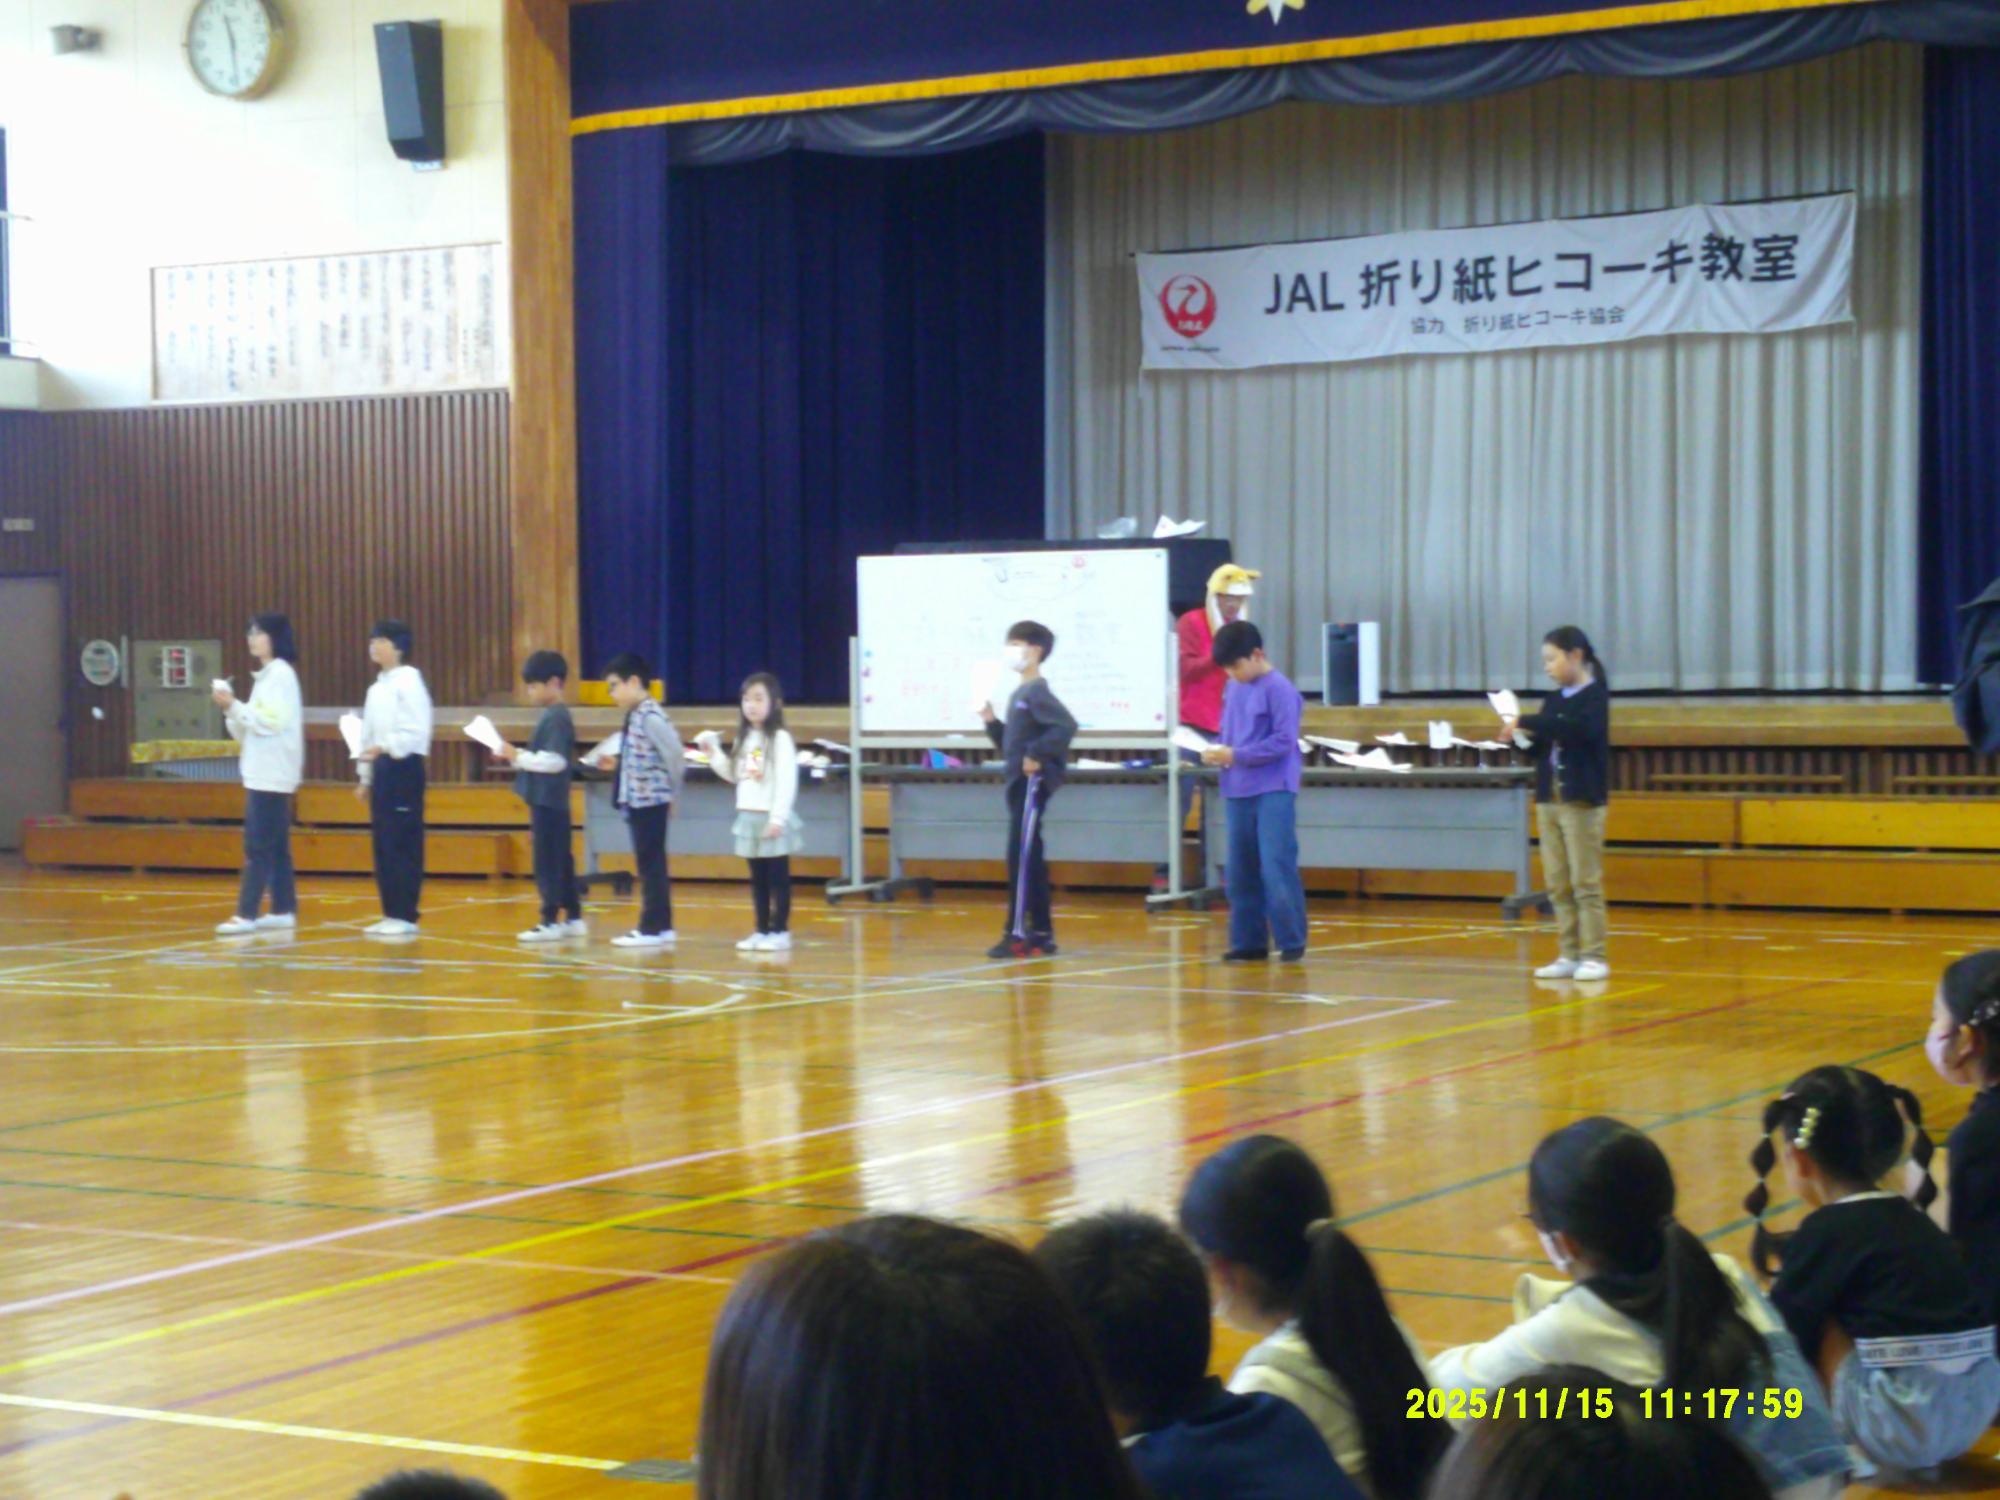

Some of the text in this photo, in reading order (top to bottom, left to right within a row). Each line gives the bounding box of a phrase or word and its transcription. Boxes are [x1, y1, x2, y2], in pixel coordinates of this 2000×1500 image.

[1264, 234, 1799, 315] JAL 折り紙ヒコーキ教室
[1411, 306, 1625, 335] 協力 折り紙ヒコーキ協会
